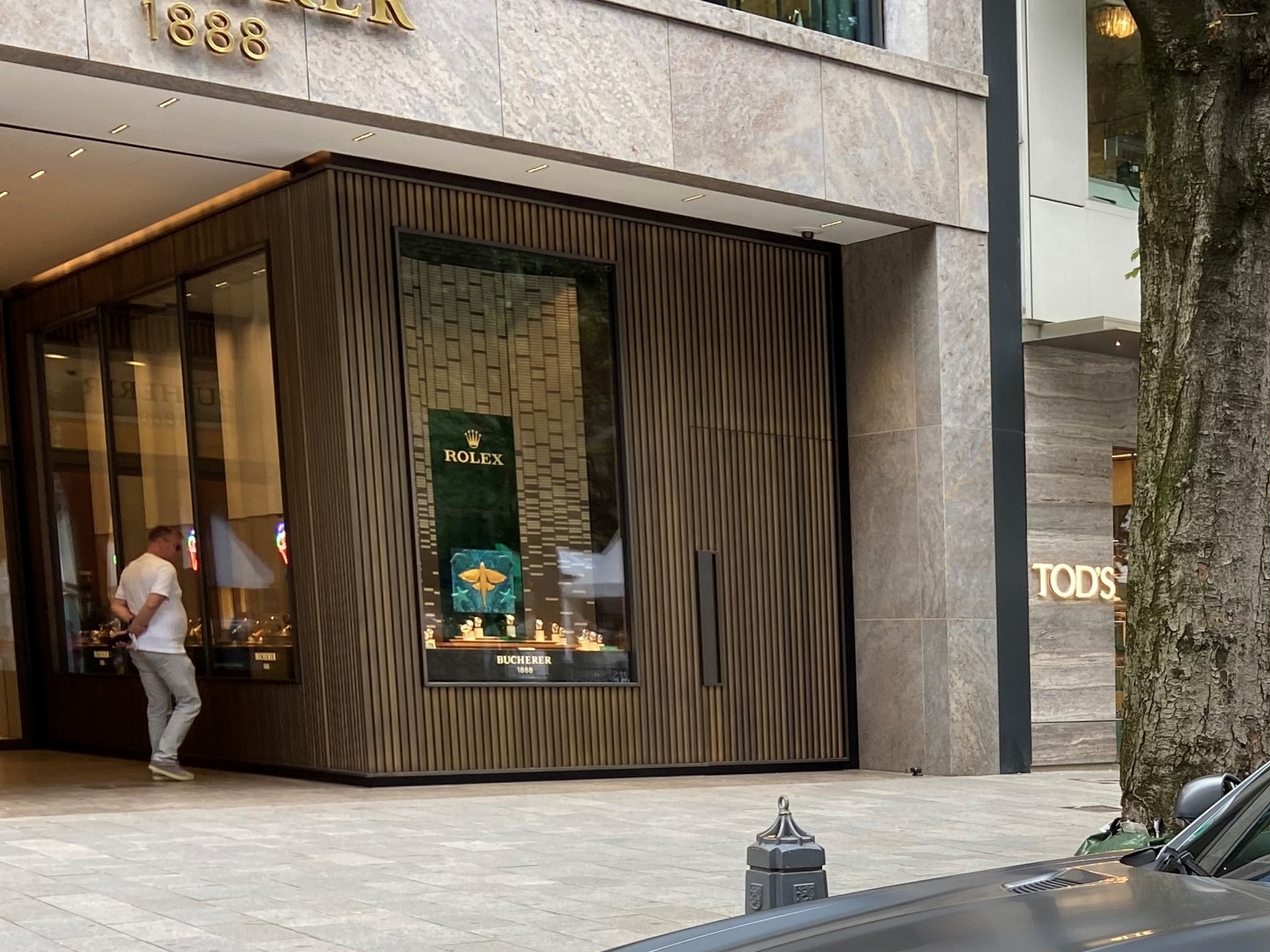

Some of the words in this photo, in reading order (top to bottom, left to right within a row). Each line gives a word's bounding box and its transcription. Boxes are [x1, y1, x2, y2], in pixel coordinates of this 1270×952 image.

[137, 0, 270, 60] 1888
[443, 449, 504, 466] ROLEX
[1031, 563, 1116, 600] TOD'S
[496, 655, 552, 665] BUCHERER
